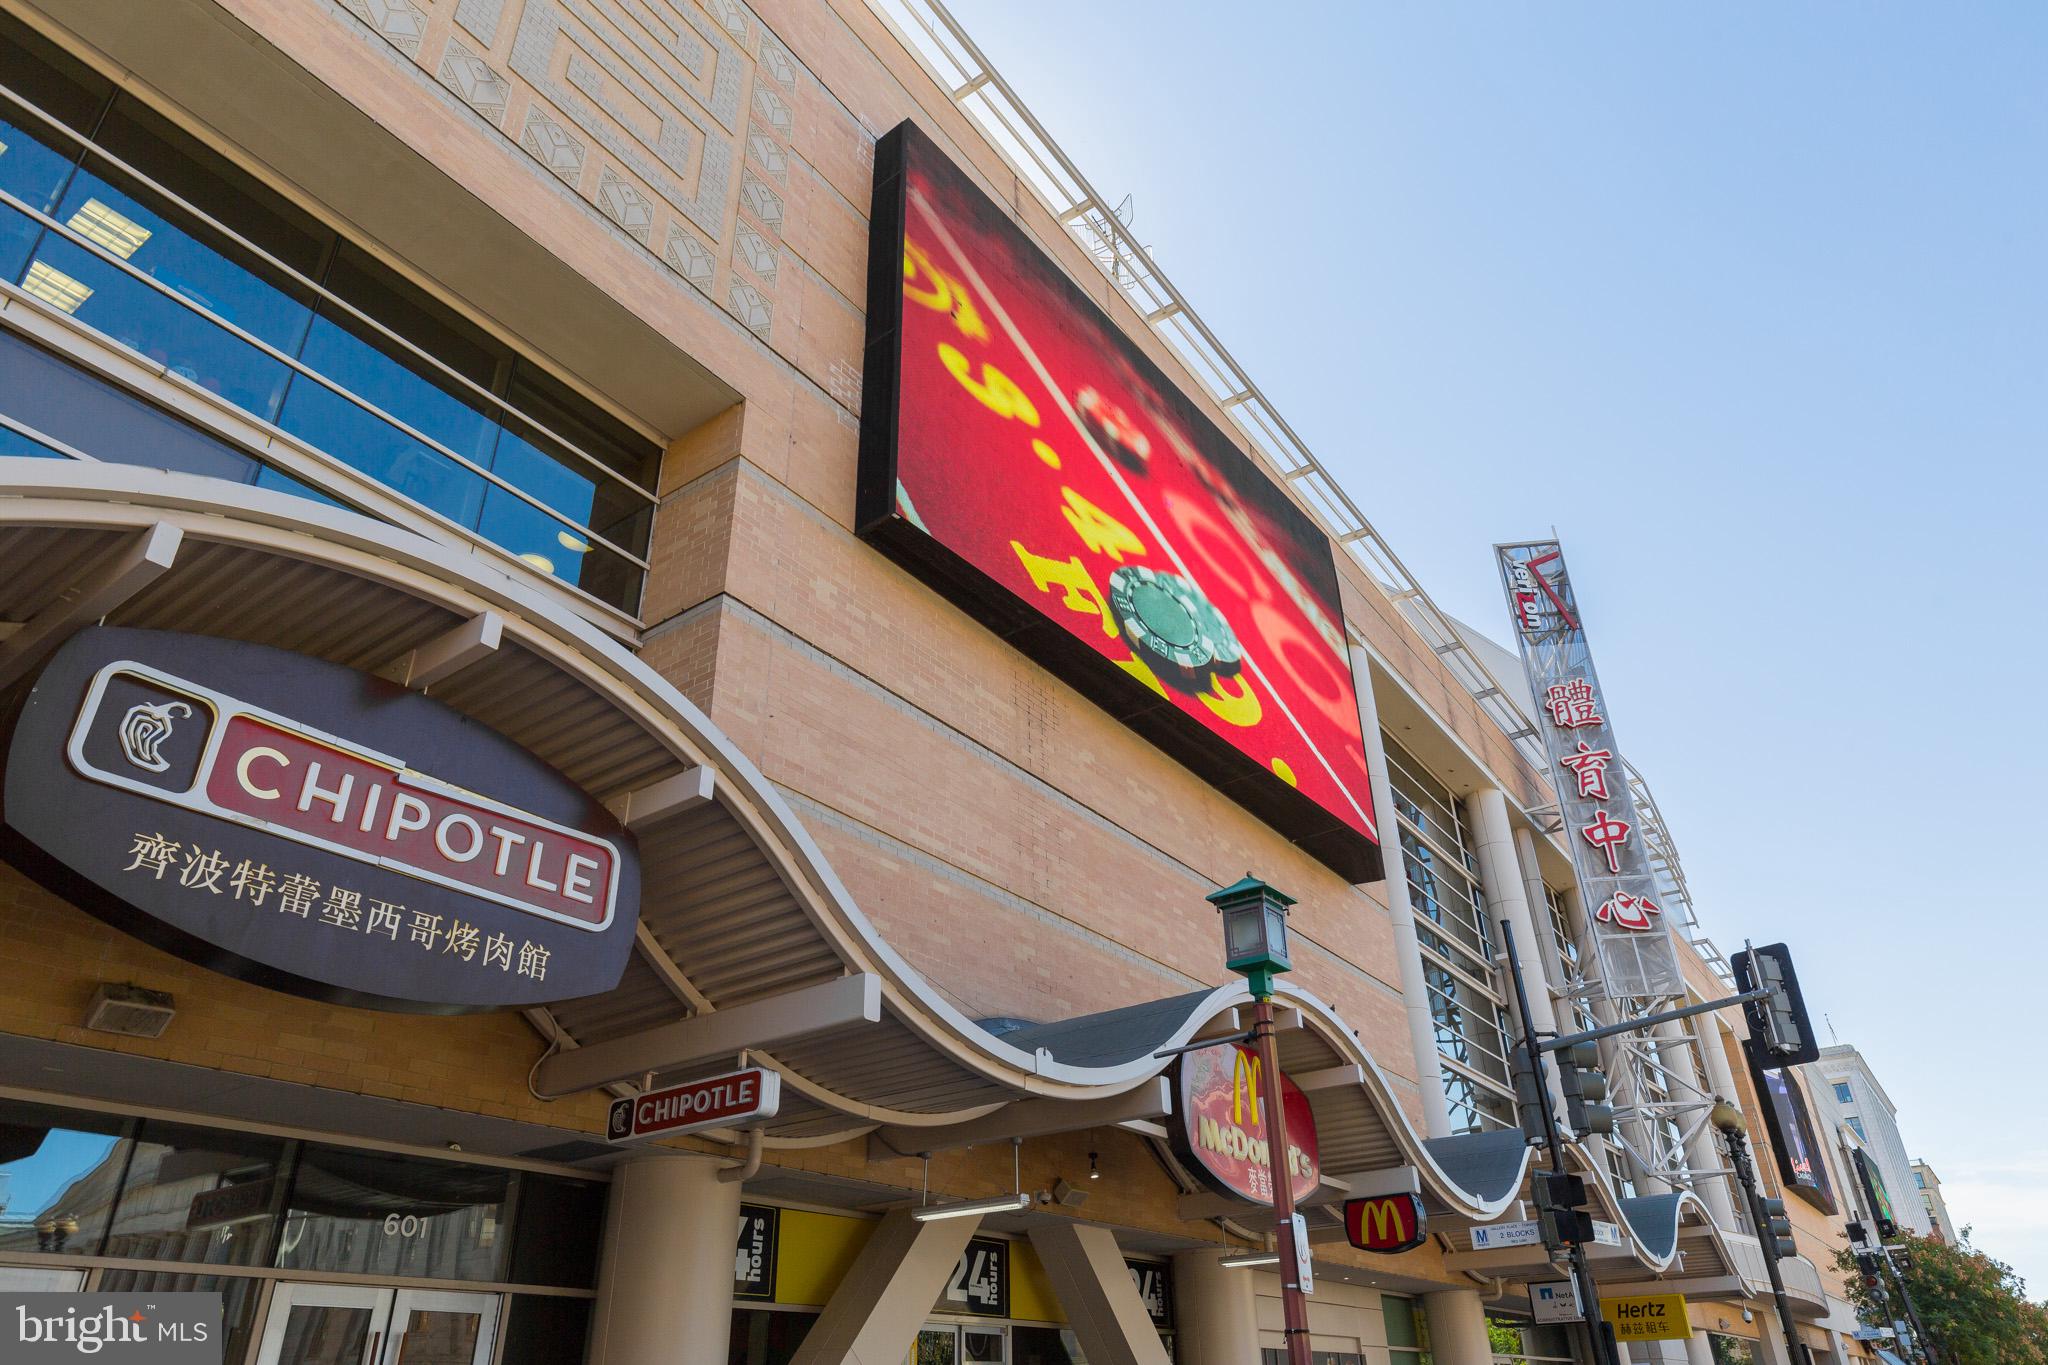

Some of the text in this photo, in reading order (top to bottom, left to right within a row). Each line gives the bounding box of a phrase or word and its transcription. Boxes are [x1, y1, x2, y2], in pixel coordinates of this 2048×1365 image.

[1512, 560, 1541, 629] verizon
[236, 746, 599, 904] CHIPOTLE
[1545, 678, 1662, 930] 體育中心
[638, 1079, 754, 1125] CHIPOTLE
[384, 1213, 428, 1239] 601
[747, 1218, 765, 1282] hours
[1506, 1229, 1535, 1239] BLOCKS
[988, 1252, 998, 1305] hours
[1155, 1271, 1165, 1317] hours
[1617, 1301, 1666, 1319] Hertz
